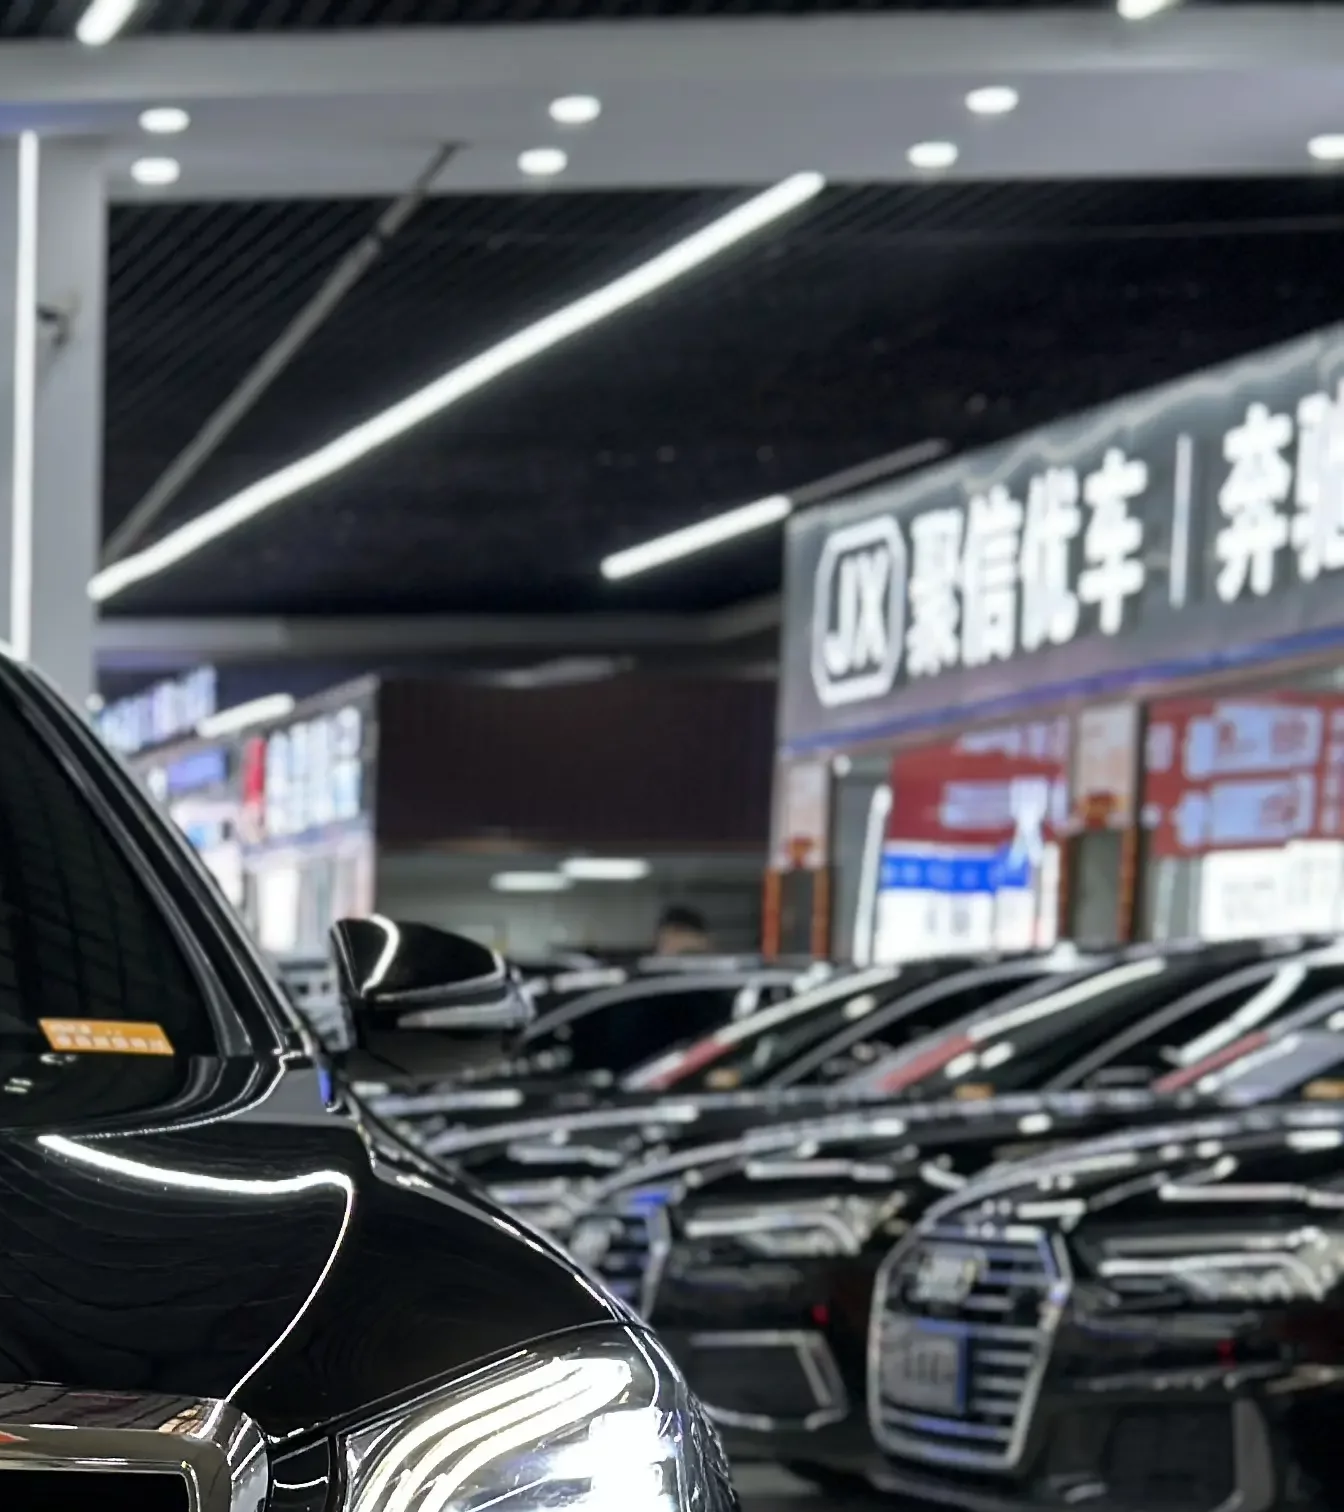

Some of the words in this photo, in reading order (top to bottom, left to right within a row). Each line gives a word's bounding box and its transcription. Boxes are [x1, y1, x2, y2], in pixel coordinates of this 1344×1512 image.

[821, 550, 889, 674] JX
[907, 447, 1148, 676] 聚信优车
